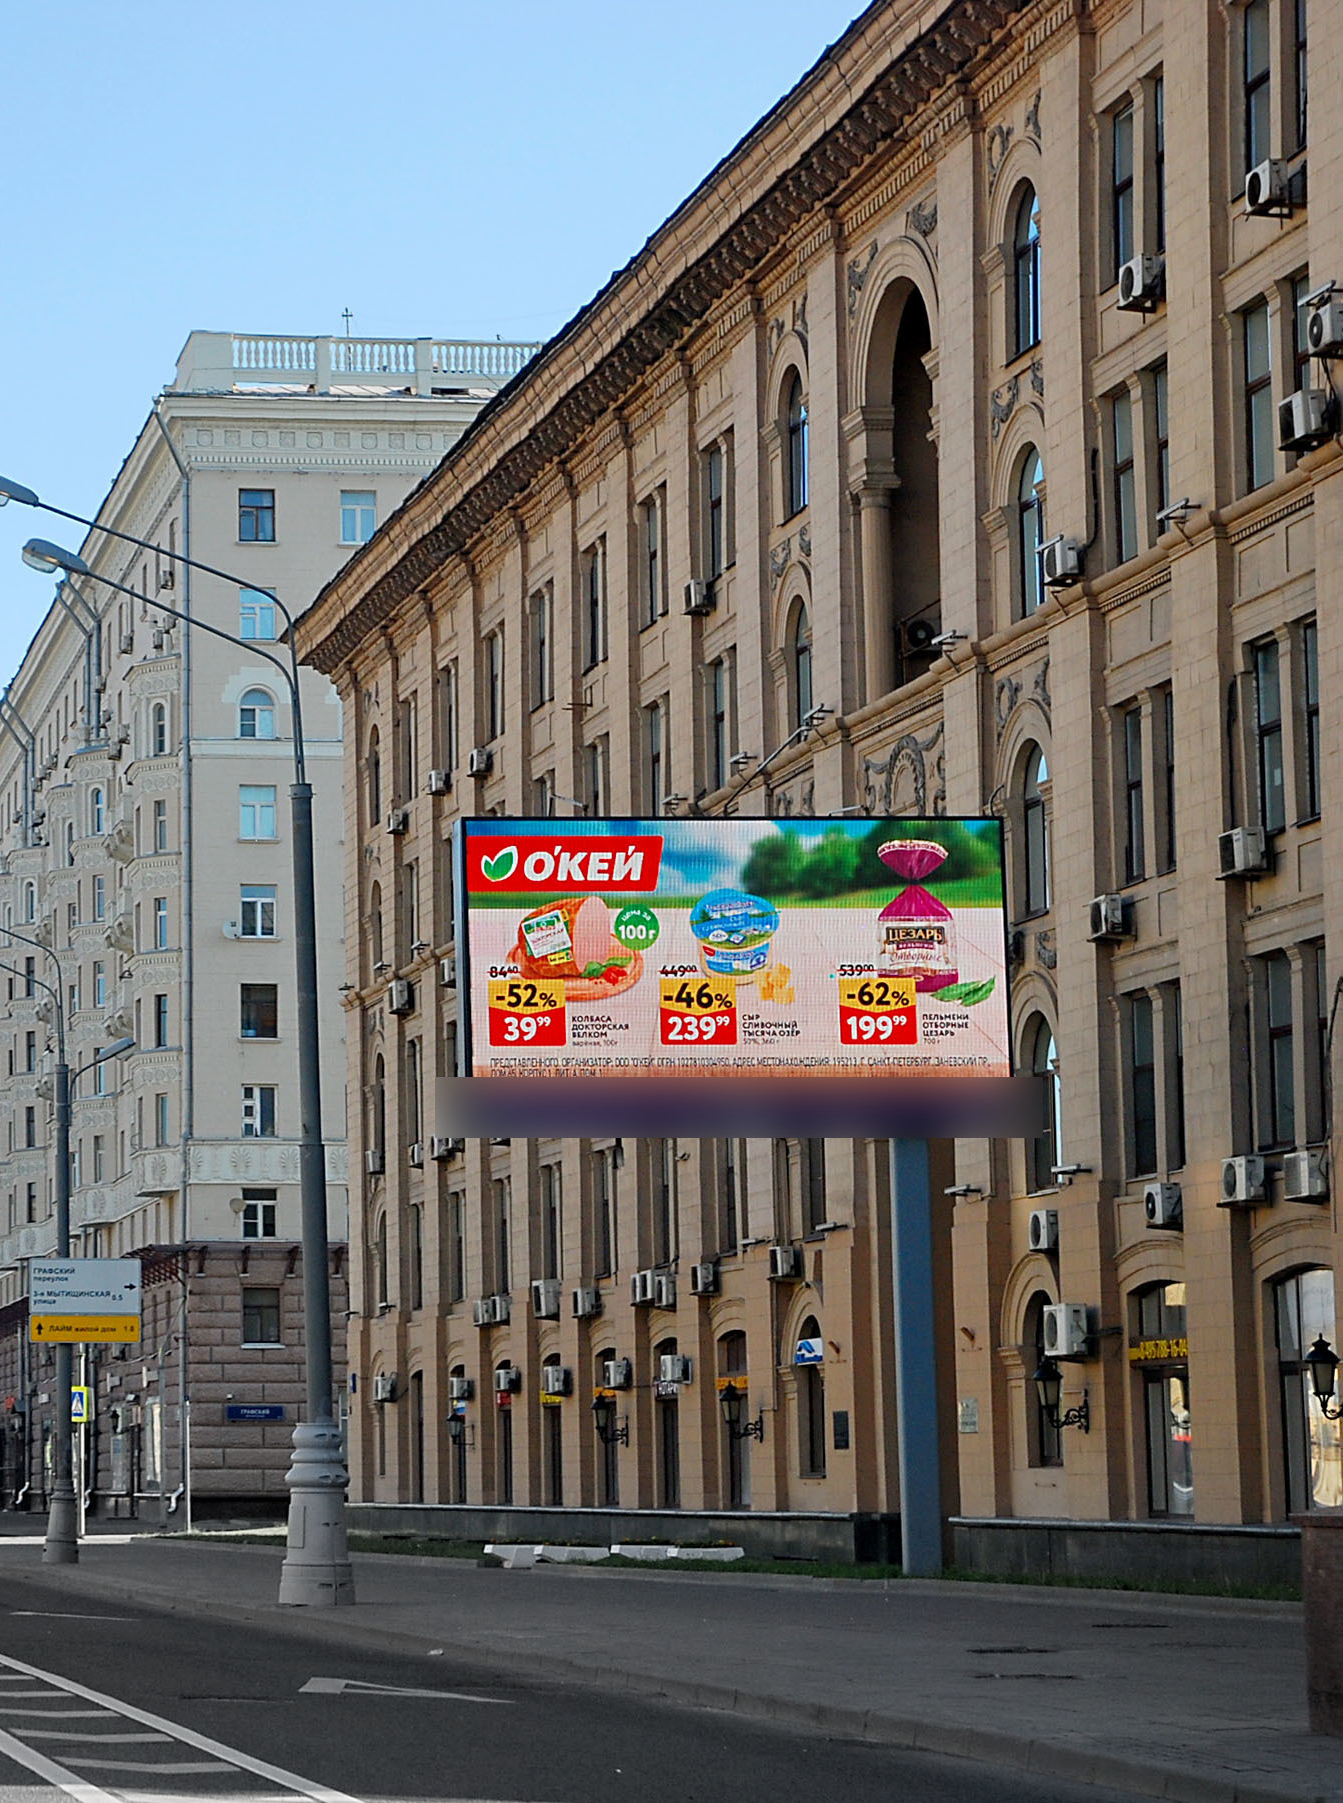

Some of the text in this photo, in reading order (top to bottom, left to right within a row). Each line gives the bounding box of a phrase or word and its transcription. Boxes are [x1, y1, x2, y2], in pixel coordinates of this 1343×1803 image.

[523, 845, 645, 882] О'КЕЙ
[618, 924, 647, 940] 100
[888, 928, 943, 942] ЦЕЗАРЬ
[495, 983, 558, 1008] -52%
[663, 982, 733, 1009] -46%
[846, 981, 910, 1007] -62%
[571, 1015, 612, 1023] КОЛБАСА
[922, 1013, 969, 1021] ПЕЛЬМЕНИ
[571, 1023, 629, 1031] ДОКТОРСКАЯ
[742, 1020, 798, 1030] СЛИВОЧНЫЙ
[922, 1021, 969, 1029] ОТБОРНЫЕ
[571, 1031, 608, 1039] ВЕЛКОМ
[742, 1029, 777, 1037] ТЫСЯЧА
[923, 1029, 955, 1038] ЦЕЗАРЬ
[923, 1037, 936, 1045] 700
[615, 1056, 630, 1067] ООО
[732, 1056, 756, 1068] АДРЕС
[32, 1266, 75, 1275] ГРАФСКИЙ
[46, 1290, 111, 1298] МЫТИЩИНСКАЯ
[48, 1324, 73, 1333] ЛАЙМ
